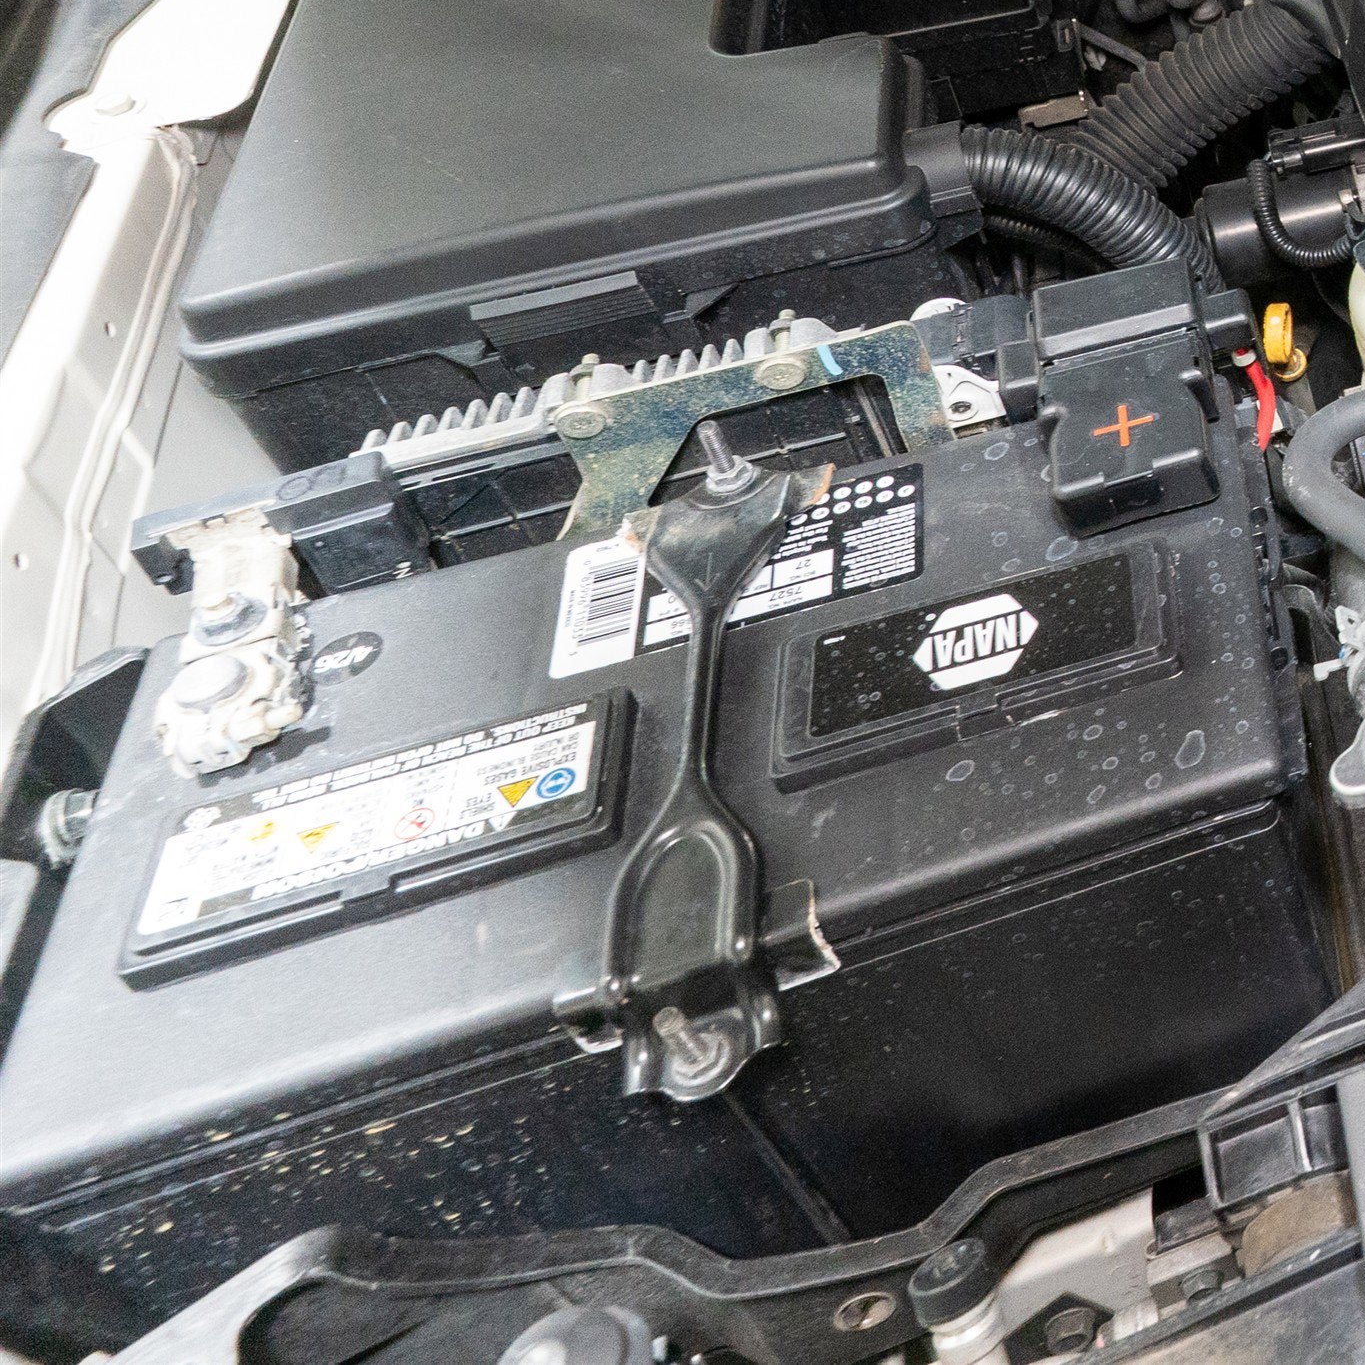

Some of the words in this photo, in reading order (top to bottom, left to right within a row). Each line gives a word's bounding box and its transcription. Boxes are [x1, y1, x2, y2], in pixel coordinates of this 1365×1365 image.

[795, 557, 811, 570] 27
[768, 584, 802, 602] 7527
[933, 613, 1018, 669] NAPA
[520, 750, 576, 775] EXPLOSIVE
[482, 767, 517, 786] GASES
